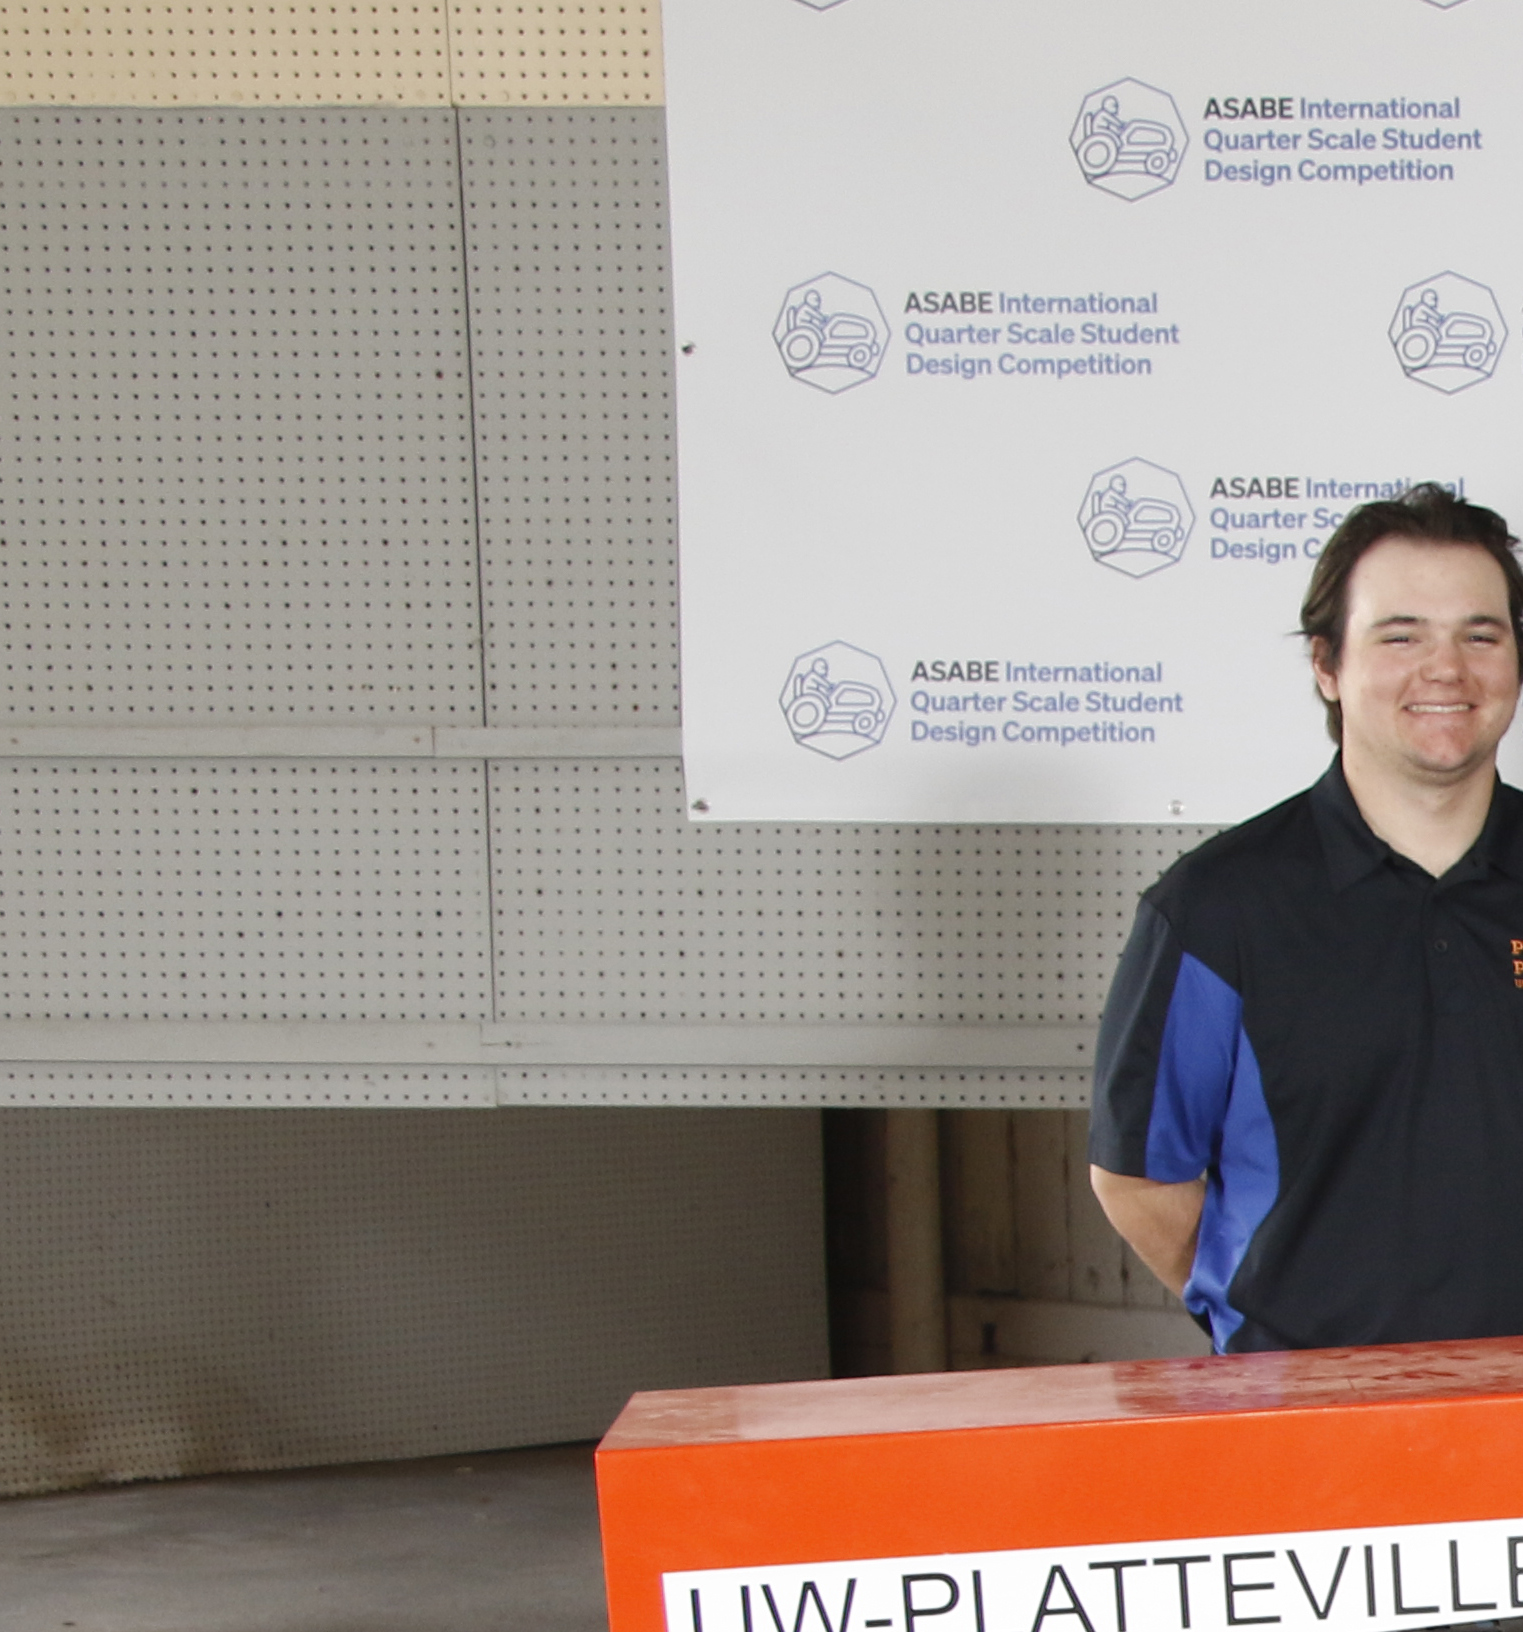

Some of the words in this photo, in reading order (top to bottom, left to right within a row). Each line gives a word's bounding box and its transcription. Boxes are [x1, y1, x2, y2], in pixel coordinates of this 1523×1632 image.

[1203, 97, 1294, 120] ASABE
[1300, 97, 1460, 119] International
[1204, 128, 1302, 153] Quarter
[1308, 128, 1377, 150] Scale
[1382, 128, 1482, 150] Student
[1205, 159, 1291, 186] Design
[1298, 159, 1453, 186] Competition
[904, 291, 993, 314] ASABE
[999, 292, 1157, 313] International
[905, 322, 1001, 347] Quarter
[1008, 323, 1075, 344] Scale
[1081, 322, 1179, 344] Student
[907, 353, 991, 379] Design
[998, 353, 1151, 379] Competition
[1210, 477, 1299, 498] ASABE
[1210, 508, 1307, 532] Quarter
[1211, 538, 1296, 564] Design
[911, 660, 999, 682] ASABE
[1006, 661, 1162, 682] International
[911, 690, 1007, 714] Quarter
[1013, 691, 1079, 712] Scale
[1086, 691, 1183, 712] Student
[911, 720, 996, 747] Design
[1002, 721, 1155, 747] Competition
